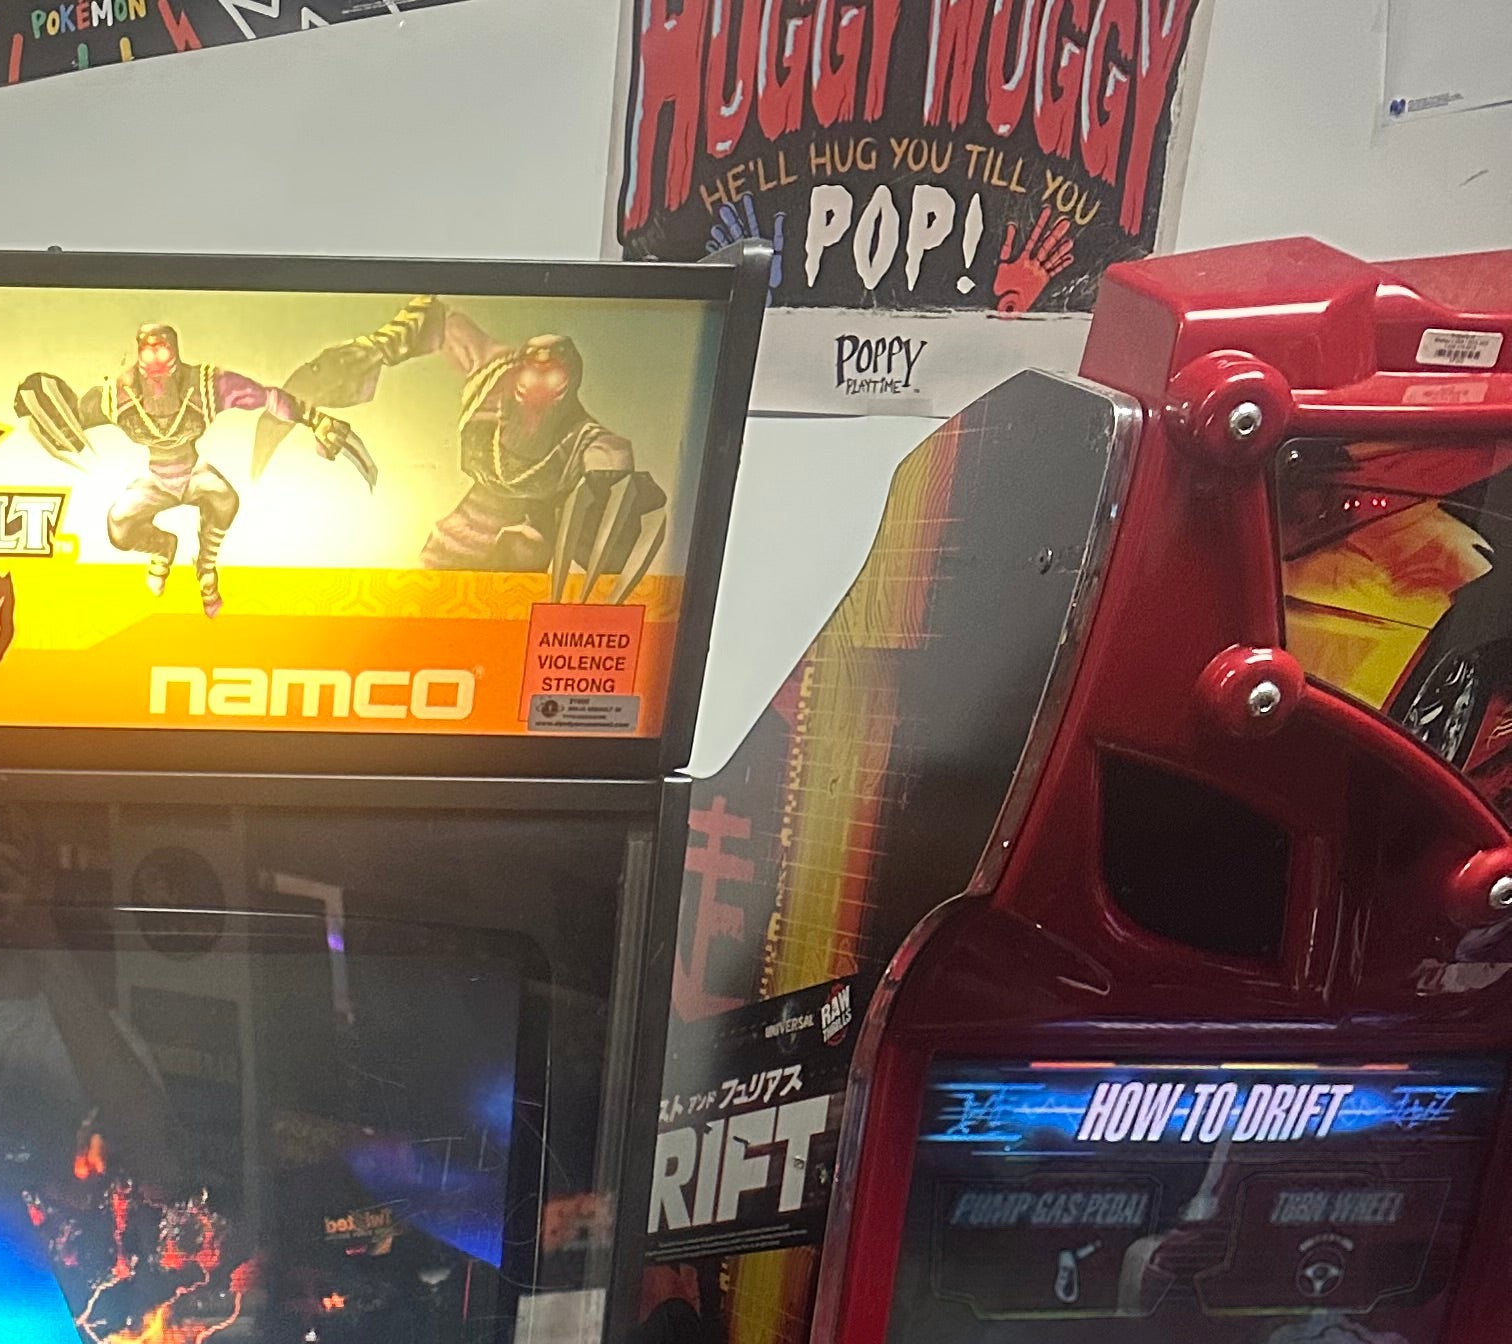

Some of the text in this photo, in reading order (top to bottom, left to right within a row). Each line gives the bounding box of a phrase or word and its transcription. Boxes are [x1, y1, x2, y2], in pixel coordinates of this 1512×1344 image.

[622, 0, 1189, 237] HUGGY WUGGY
[700, 137, 1102, 226] HE'LL HUG YOU TILL YOU
[804, 184, 984, 294] POP!
[835, 335, 928, 388] POPPY
[538, 655, 626, 671] VIOLENCE
[539, 632, 630, 649] ANIMATED
[149, 666, 475, 720] namco
[541, 677, 615, 693] STRONG
[820, 985, 850, 1026] RAW
[1077, 1081, 1186, 1142] HOW
[1180, 1081, 1238, 1143] TO
[1231, 1083, 1355, 1142] DRIFT
[647, 1095, 830, 1234] RIFT
